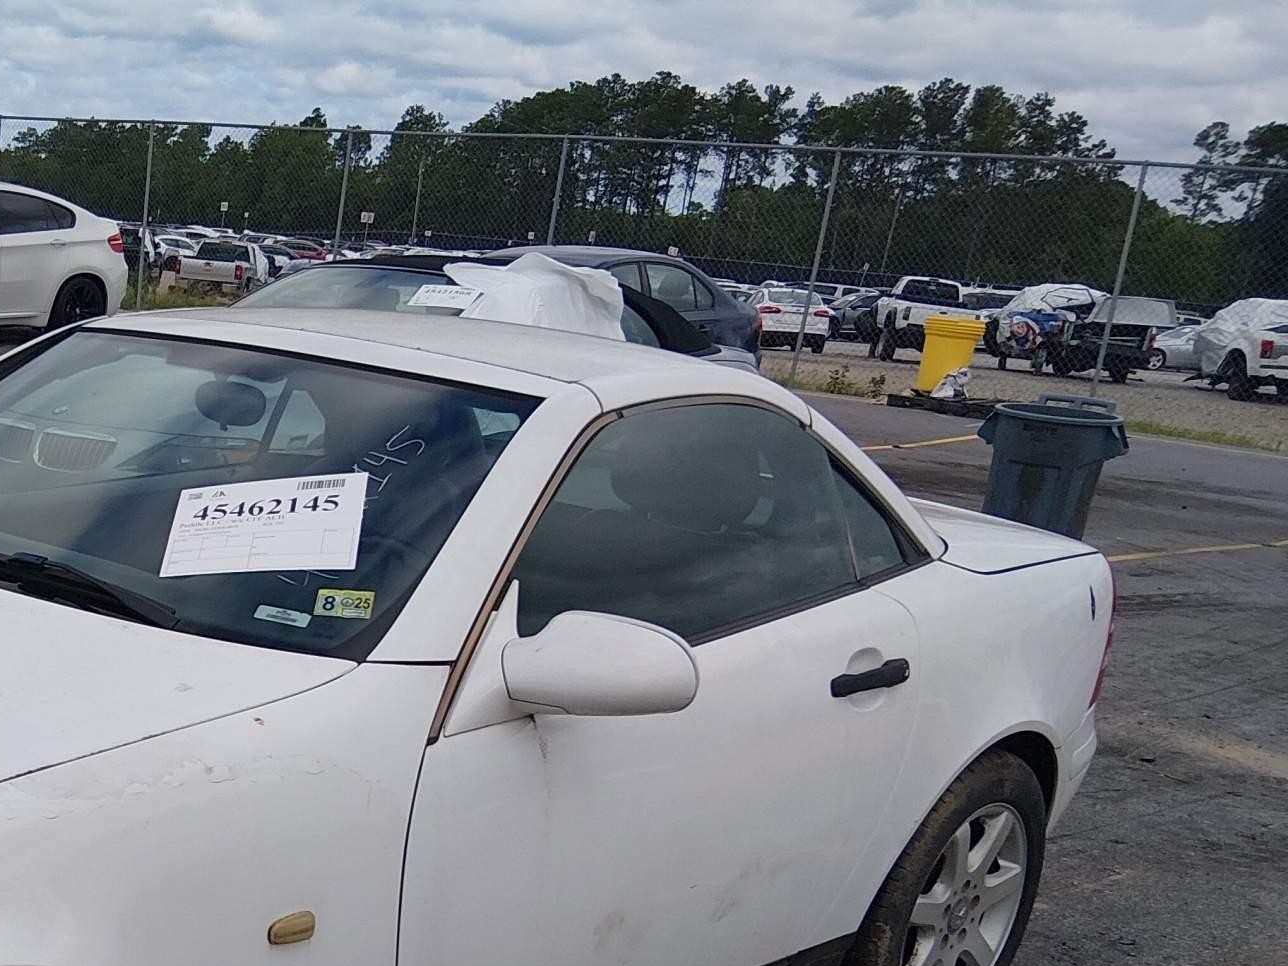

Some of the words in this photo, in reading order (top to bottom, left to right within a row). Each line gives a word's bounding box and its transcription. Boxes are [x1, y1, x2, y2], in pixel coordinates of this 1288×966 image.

[352, 424, 425, 509] 145
[192, 494, 340, 521] 45462145
[322, 595, 336, 611] 8
[354, 597, 371, 610] 25
